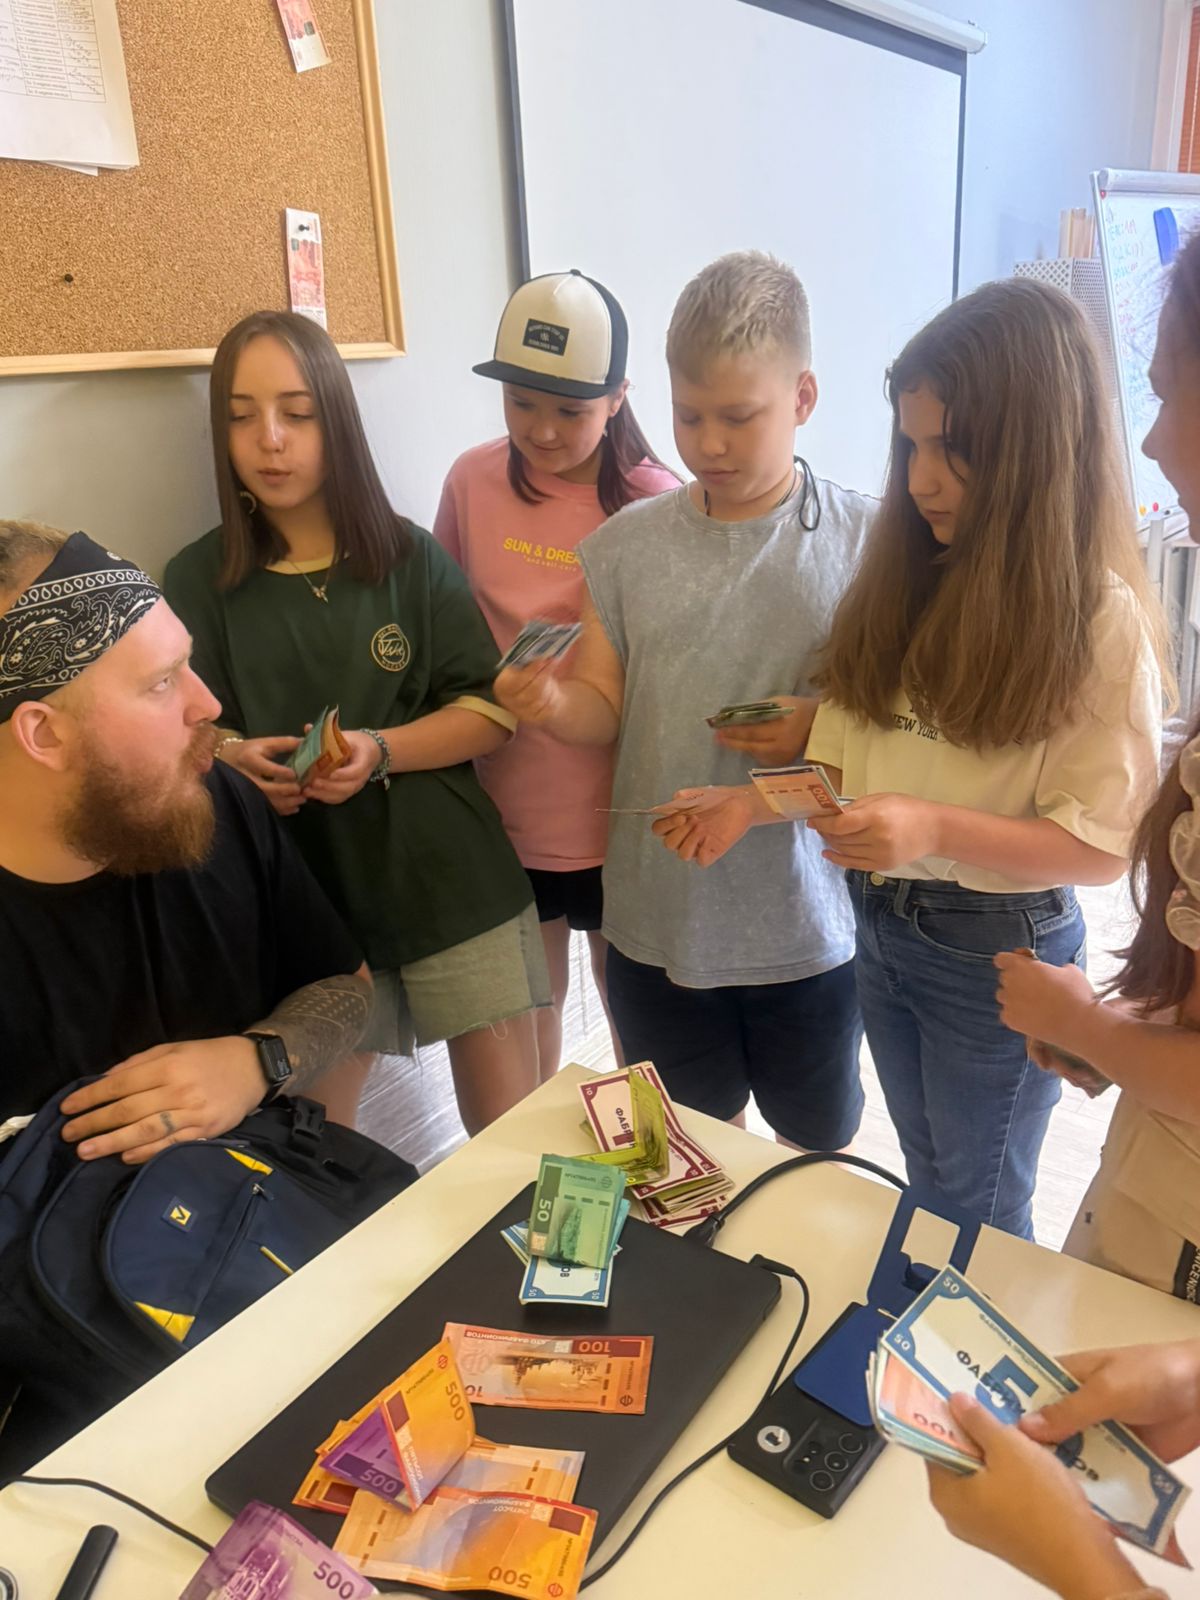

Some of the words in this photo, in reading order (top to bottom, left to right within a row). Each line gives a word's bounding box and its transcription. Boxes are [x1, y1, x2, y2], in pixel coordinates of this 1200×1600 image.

[503, 537, 532, 555] SUN
[534, 544, 542, 557] &
[537, 1198, 551, 1223] 50
[943, 1277, 960, 1294] 50
[579, 1341, 611, 1354] 100
[894, 1334, 911, 1351] 50
[445, 1382, 465, 1421] 500
[360, 1469, 398, 1494] 500
[313, 1561, 355, 1600] 500
[488, 1566, 532, 1589] 500
